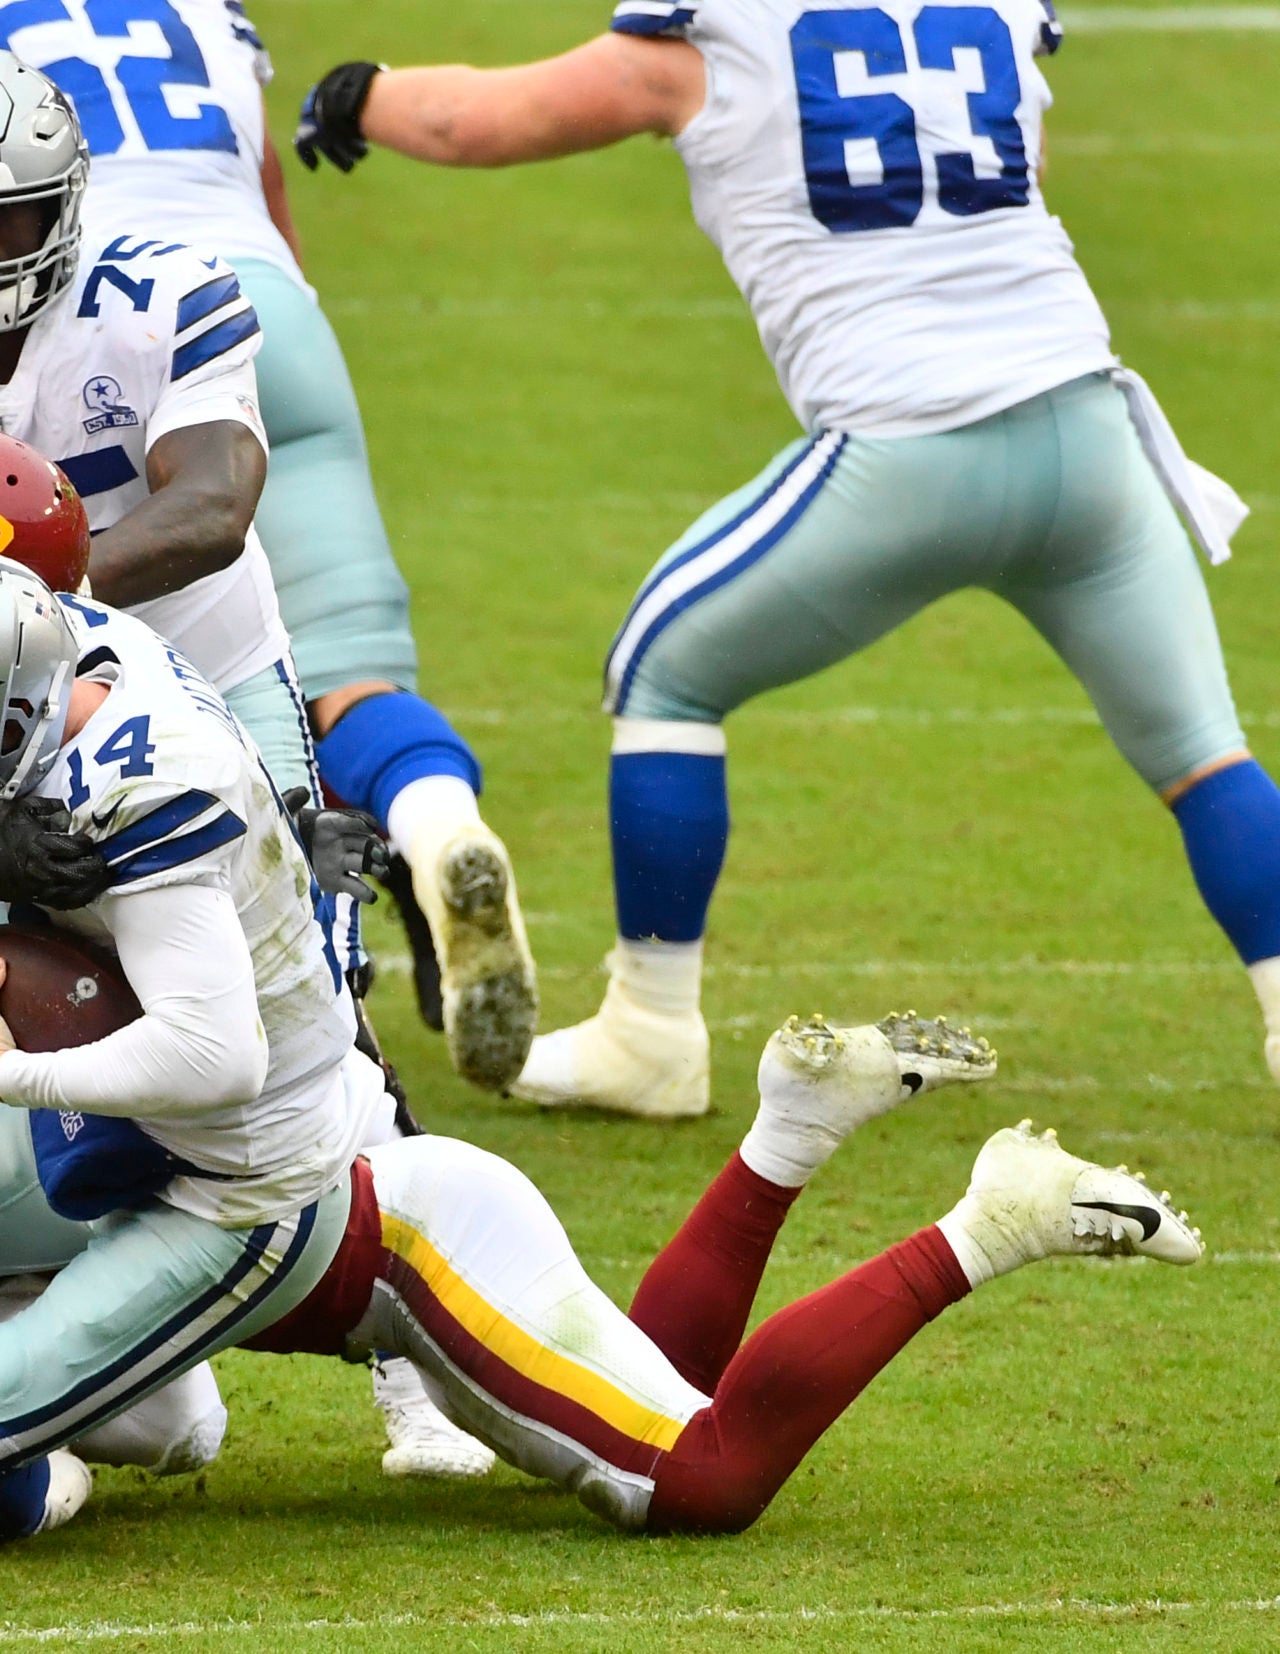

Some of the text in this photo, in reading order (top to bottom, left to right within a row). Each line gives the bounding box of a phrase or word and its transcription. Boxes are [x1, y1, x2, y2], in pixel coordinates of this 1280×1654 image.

[790, 7, 1030, 232] 63
[76, 234, 193, 318] 75
[66, 714, 156, 812] 14
